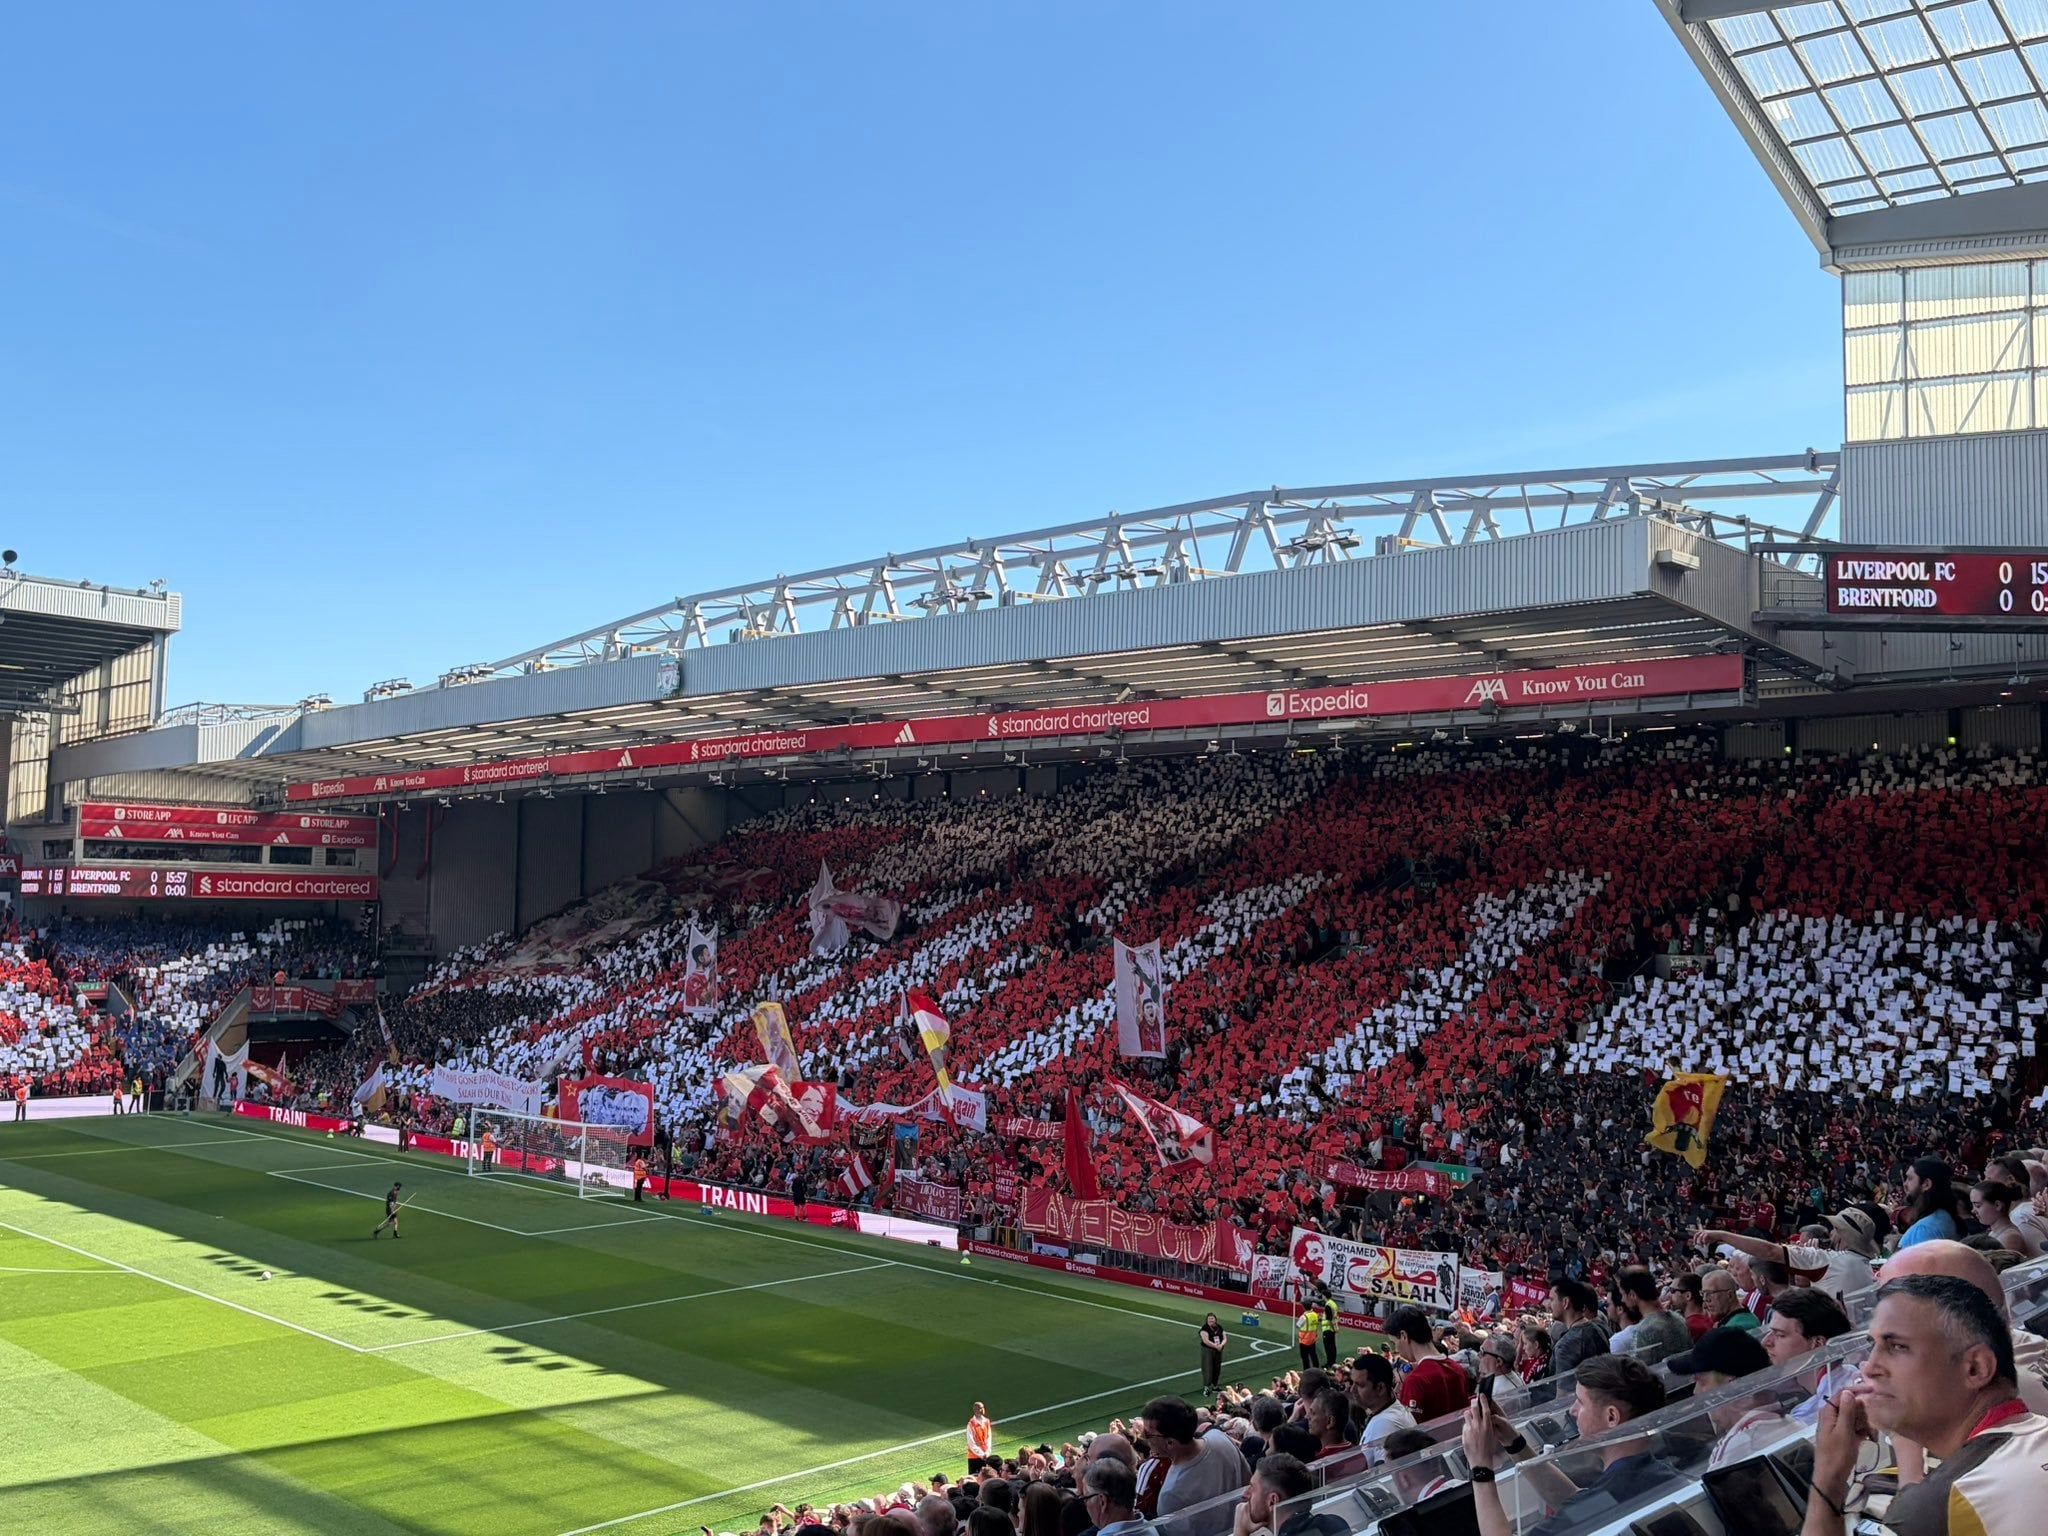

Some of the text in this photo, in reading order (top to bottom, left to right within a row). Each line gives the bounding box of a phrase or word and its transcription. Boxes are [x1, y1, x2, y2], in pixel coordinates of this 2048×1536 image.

[1837, 560, 1930, 581] LIVERPOOL
[1934, 561, 1956, 582] FC
[1999, 562, 2013, 584] 0
[1838, 587, 1938, 608] BRENTFORD
[2000, 589, 2013, 612] 0
[1464, 673, 1646, 703] AXA Know You Can
[1289, 690, 1369, 715] Expedia
[1001, 706, 1149, 735] standard chartered
[701, 734, 806, 757] standard chartered
[471, 760, 550, 781] standard chartered
[319, 781, 345, 796] Expedia
[373, 777, 387, 791] AXA
[127, 809, 171, 821] STORE APP
[228, 814, 258, 825] LFC APP
[311, 818, 349, 829] STORE APP
[164, 828, 239, 840] AXA Know You Can
[331, 835, 365, 845] Expedia
[71, 869, 118, 881] LIVERPOOL
[120, 870, 131, 882] FC
[150, 871, 158, 883] 0
[165, 871, 187, 883] 15:57
[70, 882, 121, 894] BRENTFORD
[150, 883, 158, 895] 0
[165, 883, 186, 896] 0:00
[216, 878, 370, 895] standard chartered
[268, 1106, 307, 1127] TRAINI
[1007, 1117, 1062, 1140] WE LOVE
[1354, 1167, 1380, 1189] WE
[698, 1184, 768, 1215] TRAINI
[974, 1243, 1028, 1262] standard chartered
[1327, 1241, 1377, 1258] MOHAMED
[1072, 1263, 1096, 1275] Expedia
[1371, 1278, 1437, 1304] SALAH
